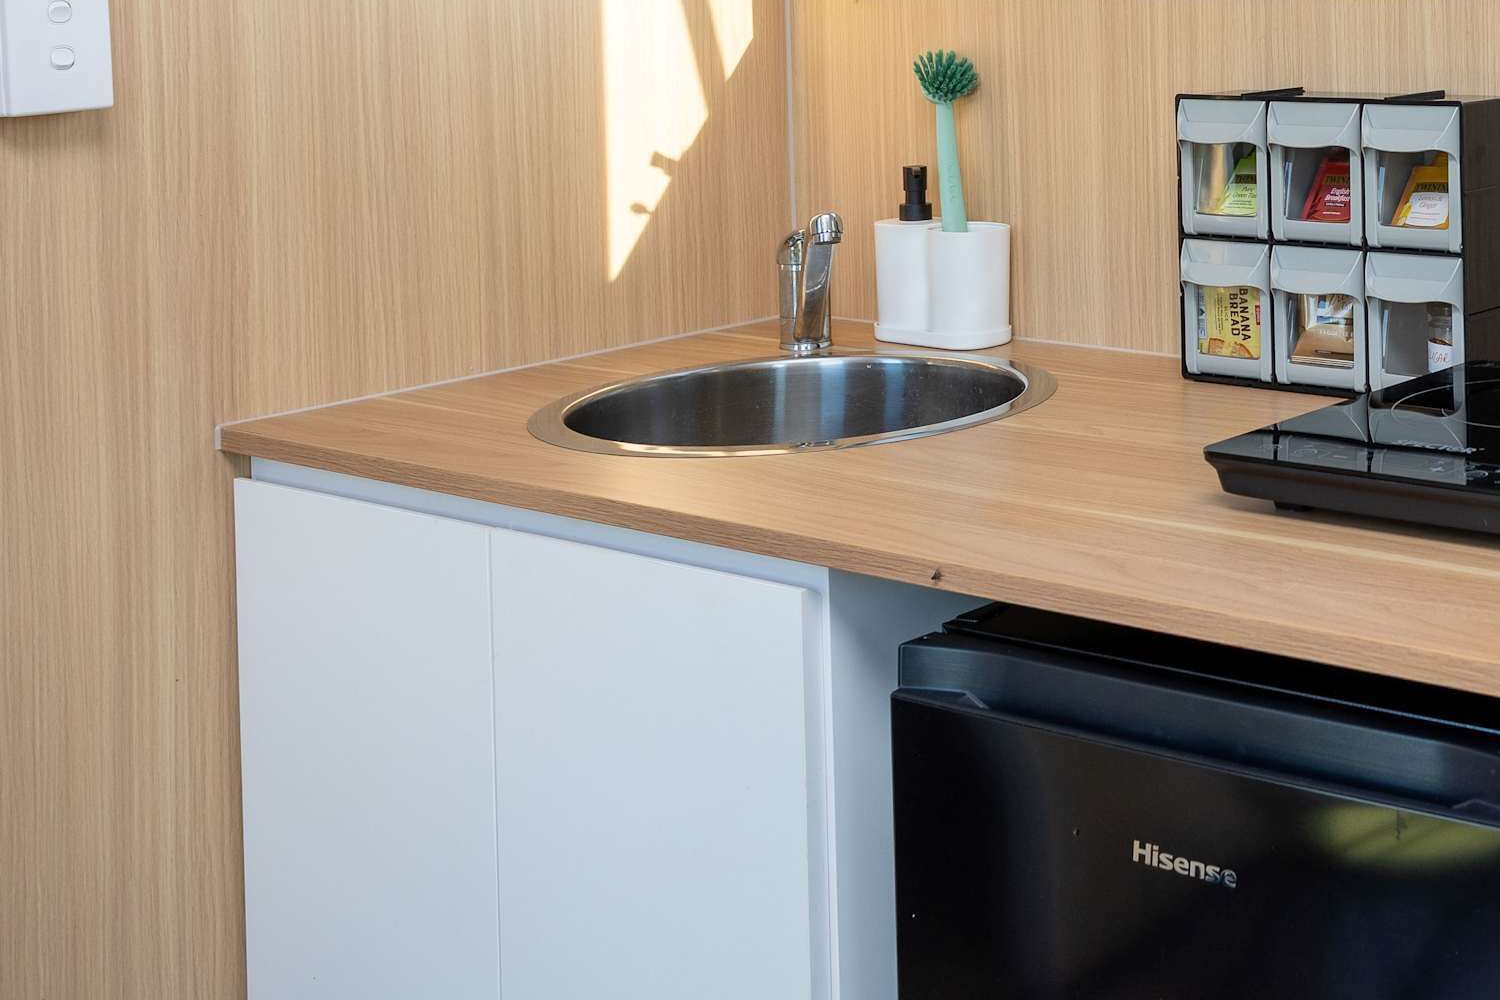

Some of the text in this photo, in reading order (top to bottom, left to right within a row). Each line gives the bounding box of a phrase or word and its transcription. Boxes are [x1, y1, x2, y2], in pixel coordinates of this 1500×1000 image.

[1229, 293, 1240, 336] BREAD
[1239, 288, 1251, 341] BANANA
[1132, 839, 1237, 889] Hisense
